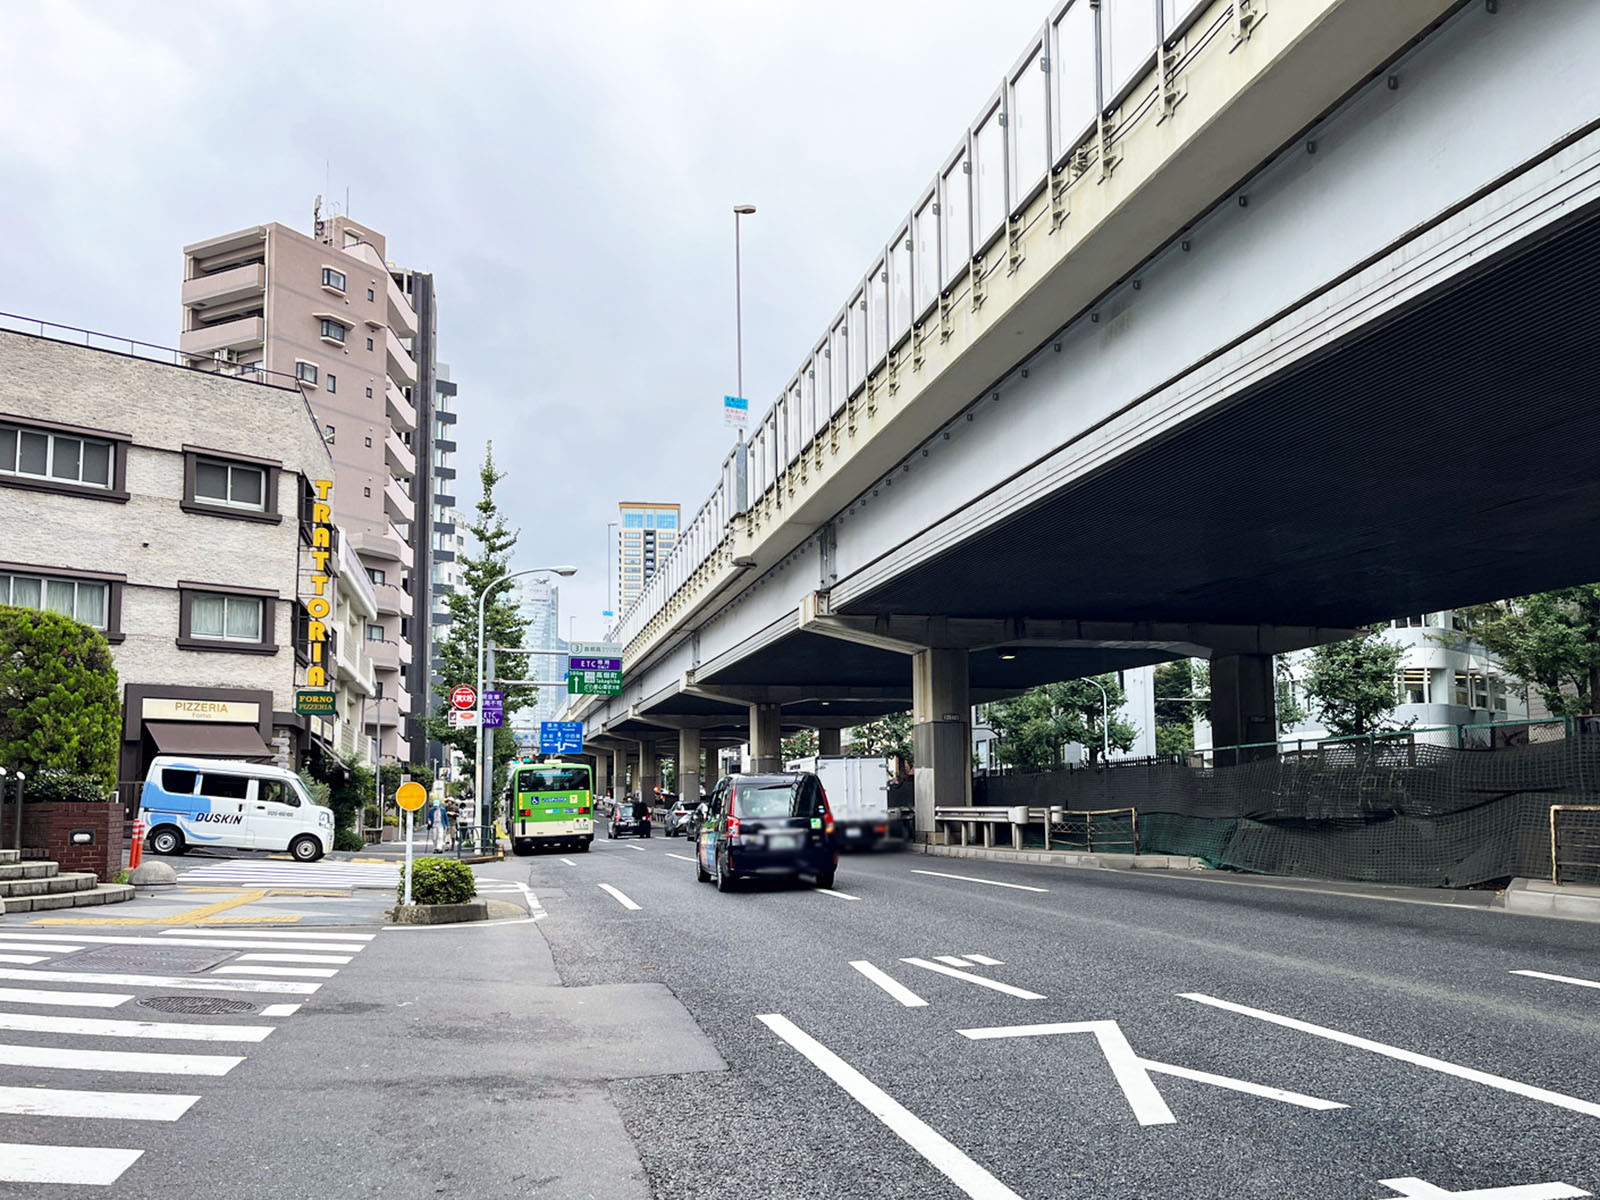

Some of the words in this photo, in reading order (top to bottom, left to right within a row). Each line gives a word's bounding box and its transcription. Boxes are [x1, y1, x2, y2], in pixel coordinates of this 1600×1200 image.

[307, 480, 333, 687] TRATTORIA
[580, 660, 596, 668] ETC
[299, 695, 333, 703] FORNO
[175, 702, 228, 713] PIZZERIA
[483, 711, 496, 719] ETC
[195, 812, 243, 825] DUSKIN
